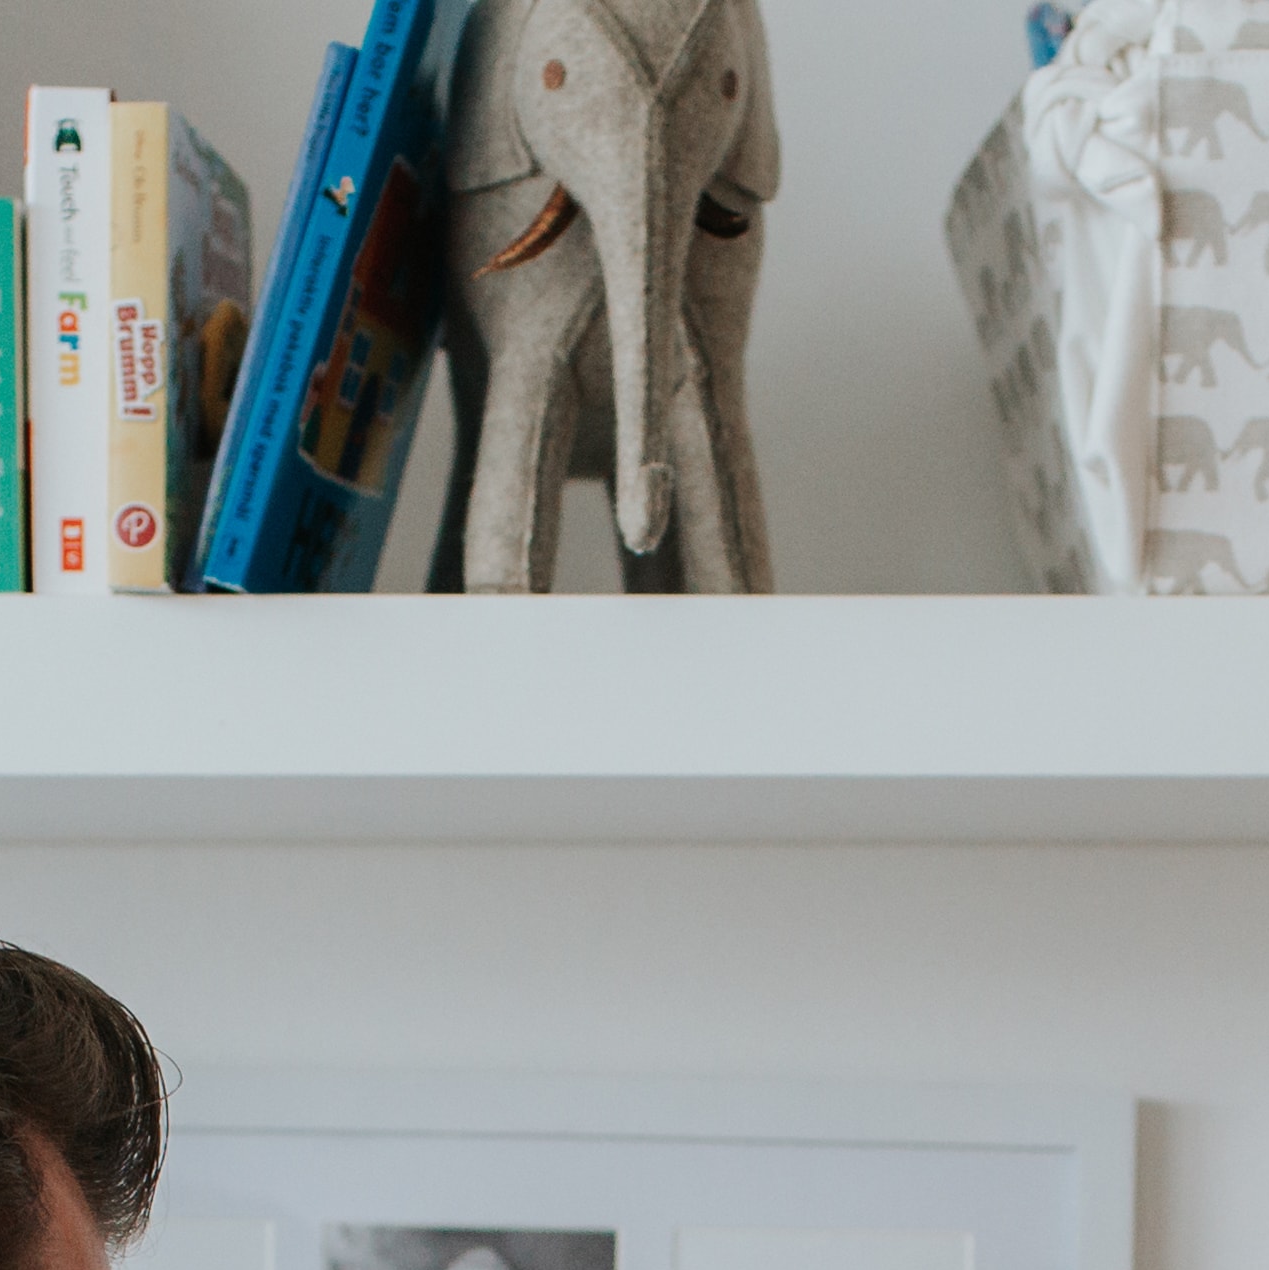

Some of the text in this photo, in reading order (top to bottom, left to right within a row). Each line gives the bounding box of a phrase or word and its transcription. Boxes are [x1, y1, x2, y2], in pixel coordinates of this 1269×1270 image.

[59, 164, 80, 222] Touch
[59, 248, 81, 281] feel
[58, 290, 88, 386] Farm
[139, 324, 158, 385] Hopp
